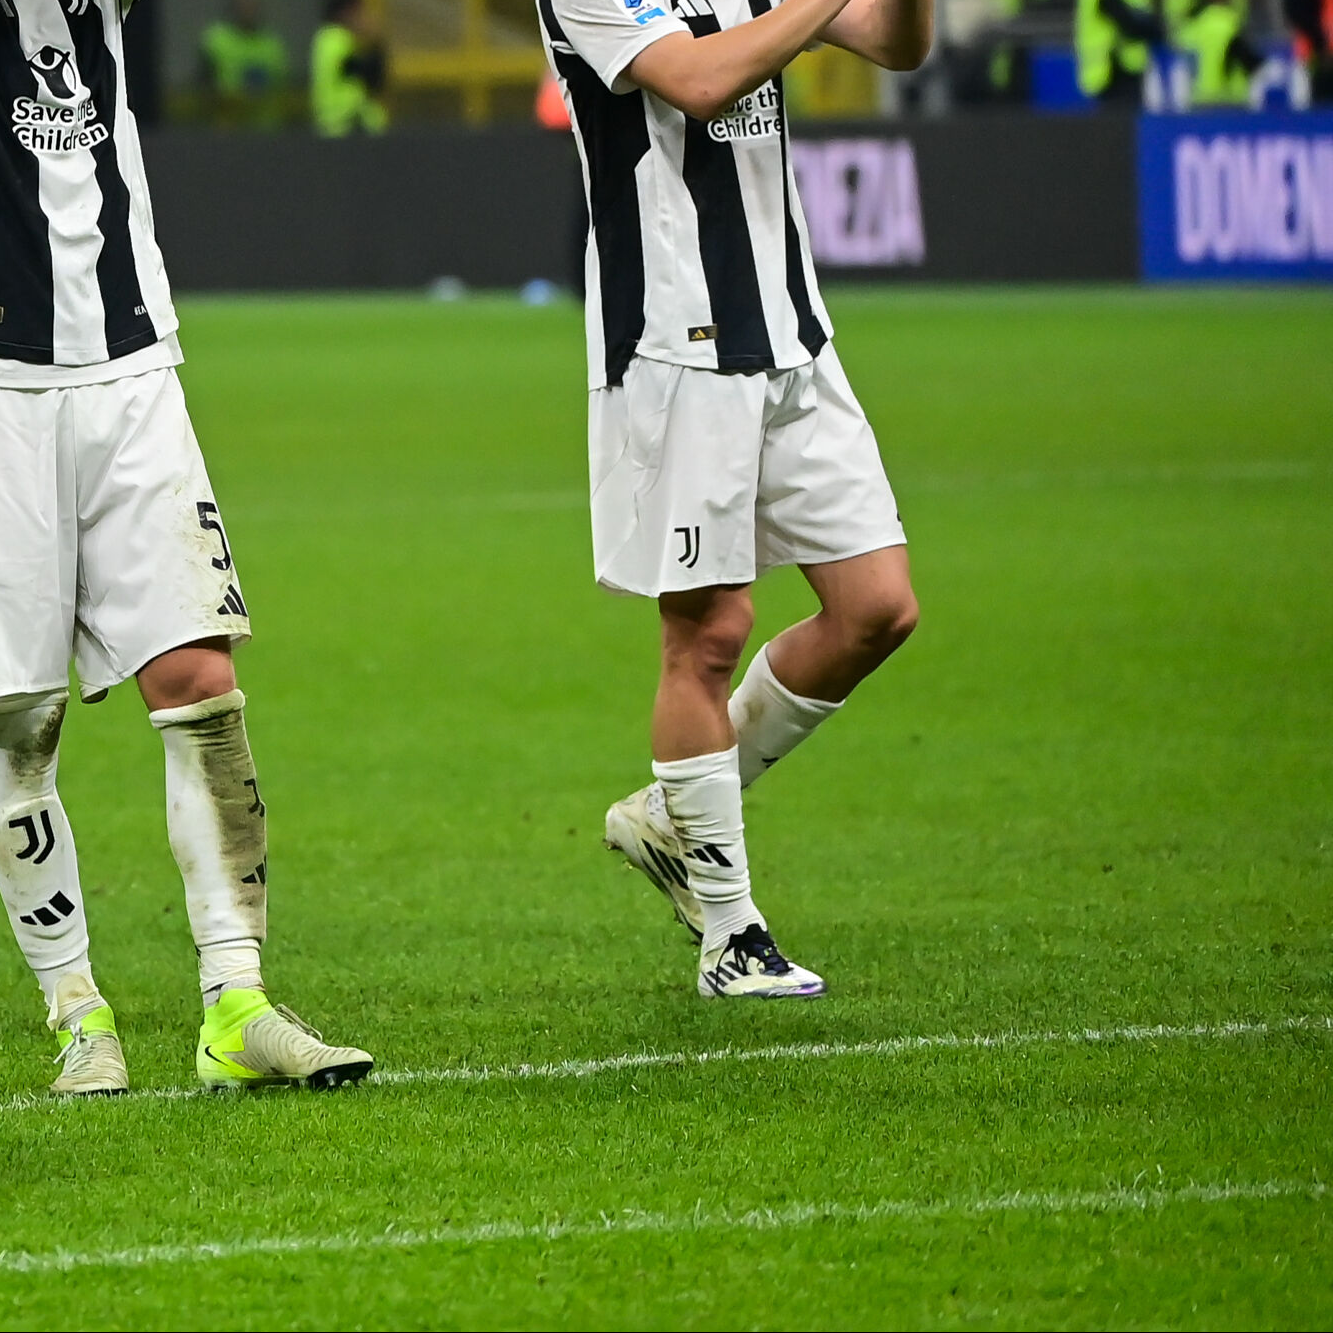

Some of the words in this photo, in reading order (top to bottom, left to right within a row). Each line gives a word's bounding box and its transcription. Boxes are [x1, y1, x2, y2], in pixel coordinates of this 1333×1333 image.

[756, 87, 779, 108] th
[15, 98, 74, 123] Save
[13, 125, 106, 151] Children
[710, 115, 782, 139] Childre
[195, 500, 231, 571] 5
